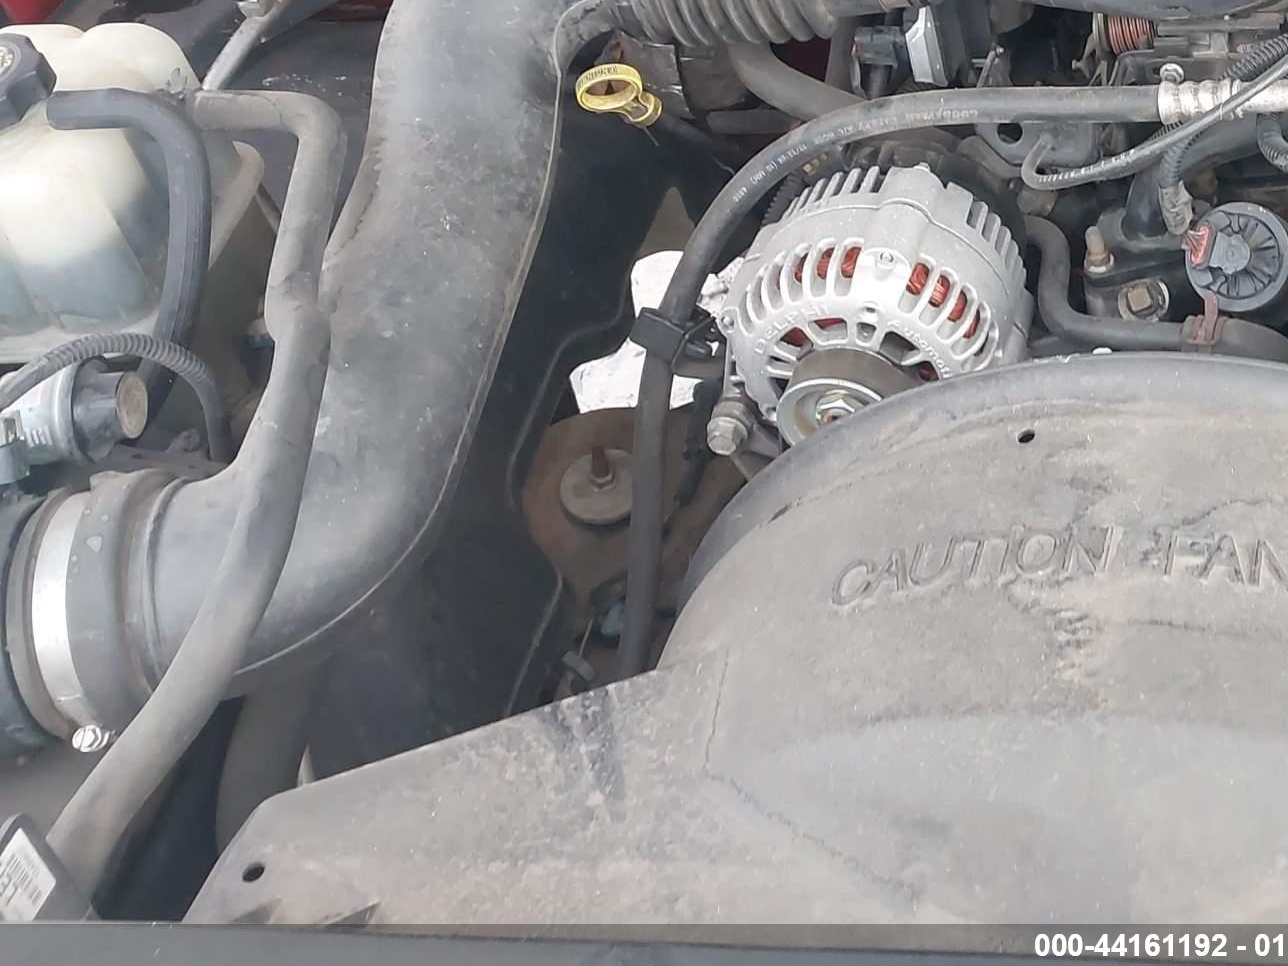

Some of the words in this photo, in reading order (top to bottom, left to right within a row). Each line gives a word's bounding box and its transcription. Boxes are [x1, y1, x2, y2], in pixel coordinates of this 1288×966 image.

[754, 305, 829, 354] DELPHI
[887, 320, 952, 379] Automoti
[831, 522, 1122, 607] CAUTION
